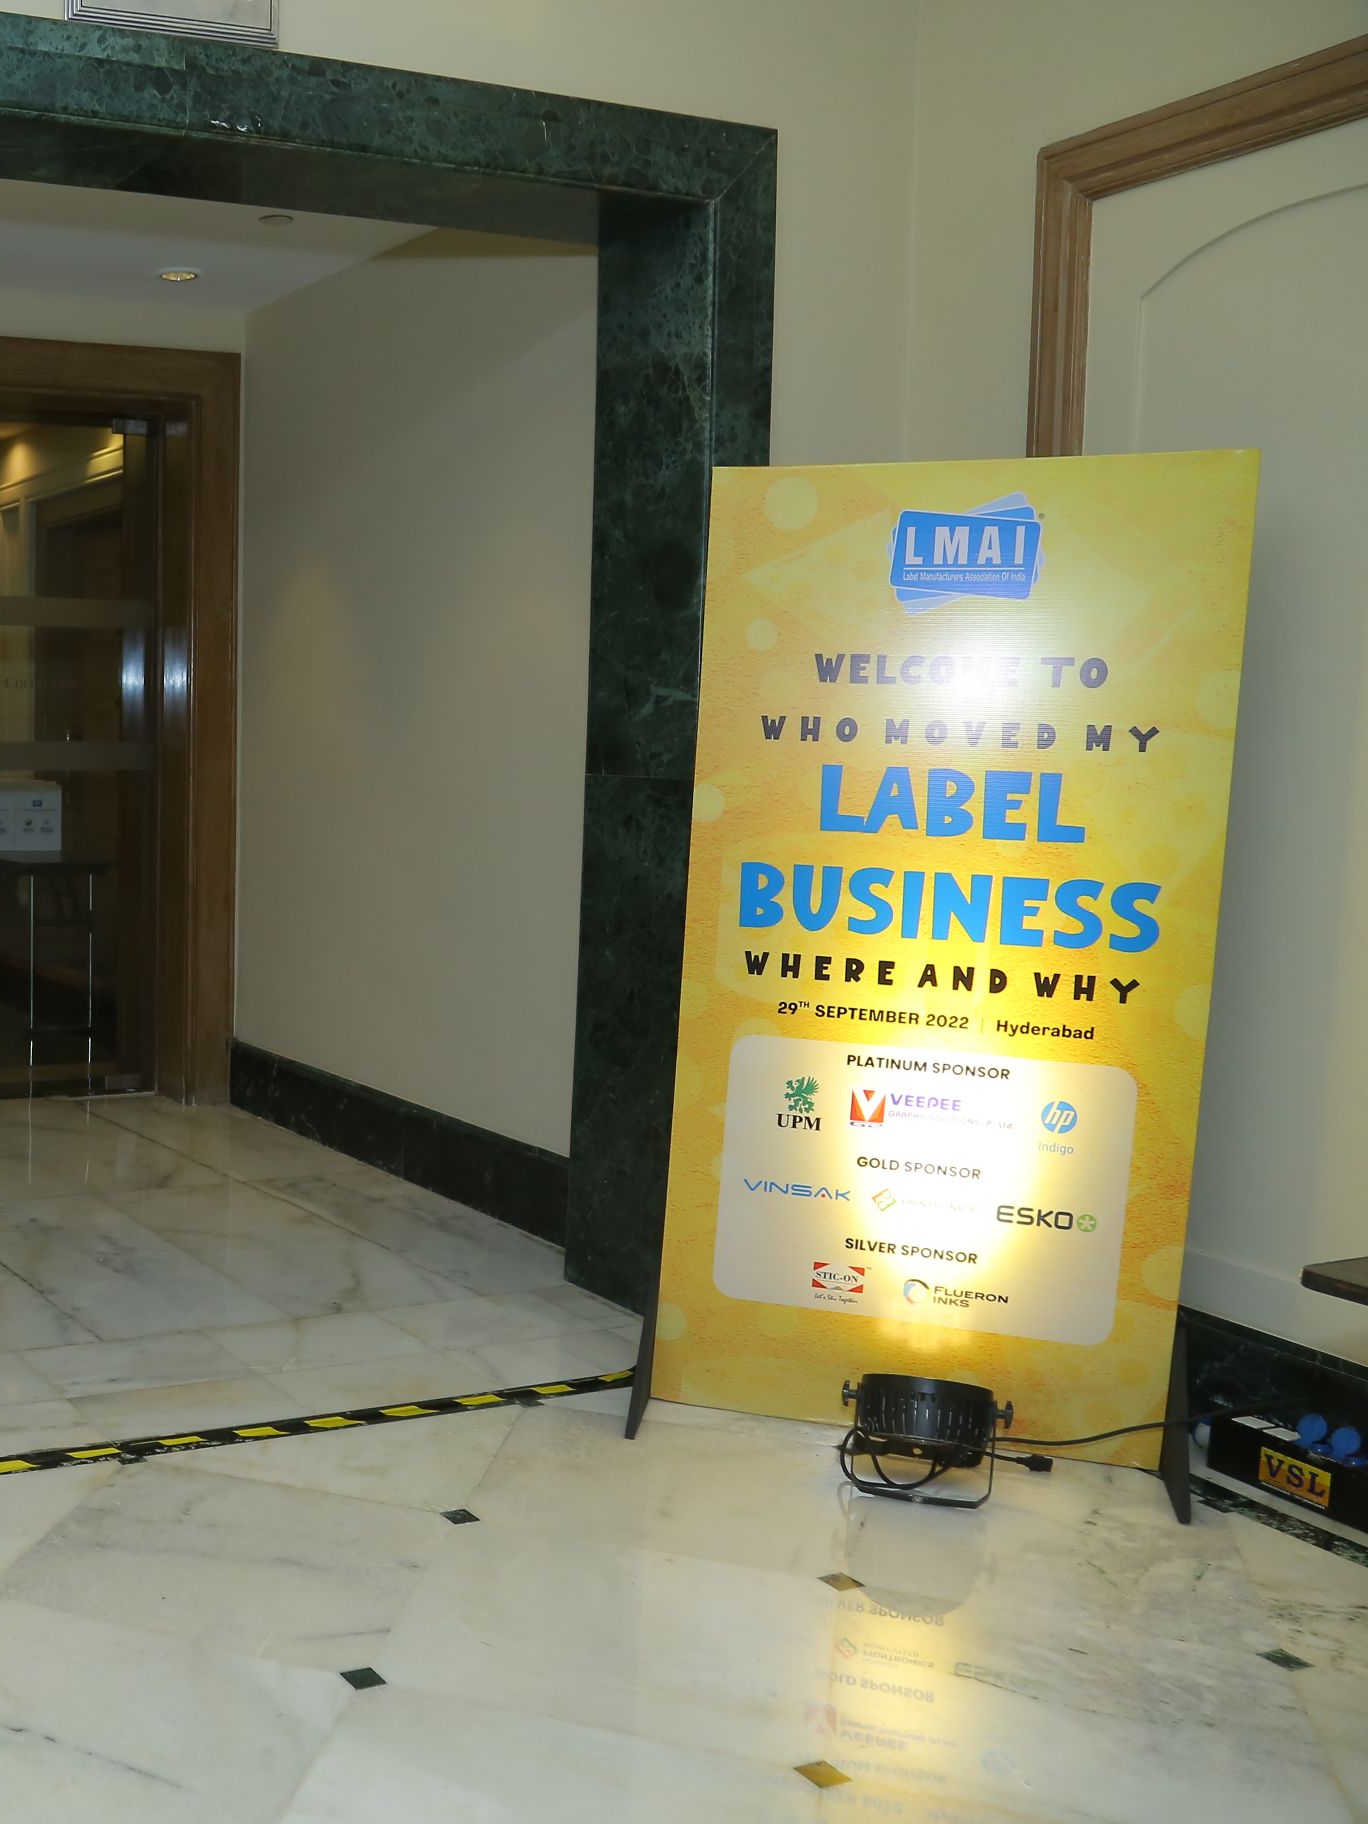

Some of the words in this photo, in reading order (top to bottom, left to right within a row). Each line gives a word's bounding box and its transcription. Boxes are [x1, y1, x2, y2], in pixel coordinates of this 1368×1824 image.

[903, 525, 1026, 565] LMAI
[903, 571, 920, 582] Label
[920, 571, 964, 582] Manufacturers
[965, 571, 1001, 582] Association
[1001, 571, 1010, 582] Of
[1010, 571, 1027, 582] India
[1040, 656, 1109, 689] TO
[760, 715, 859, 744] WHO
[884, 718, 1057, 751] MOVED
[1085, 724, 1161, 753] MY
[819, 763, 1087, 844] LABEL
[738, 861, 1162, 954] BUSINESS
[744, 950, 896, 987] WHERE
[917, 963, 1009, 995] AND
[1033, 971, 1141, 1005] WHY
[776, 1000, 811, 1018] 29TH
[814, 1003, 920, 1026] SEPTEMBER
[925, 1013, 970, 1030] 2022
[996, 1019, 1096, 1041] Hyderabad
[846, 1054, 928, 1073] PLATINUM
[932, 1062, 1011, 1081] SPONSOR
[889, 1093, 962, 1112] VEEPEE
[775, 1112, 822, 1132] UPM
[1044, 1102, 1077, 1134] hp
[1037, 1141, 1075, 1156] Indigo
[856, 1156, 900, 1172] GOLD
[904, 1161, 982, 1181] SPONSOR
[742, 1178, 852, 1202] VINSAK
[996, 1204, 1074, 1231] ESKO
[844, 1237, 897, 1255] SILVER
[901, 1244, 979, 1265] SPONSOR
[815, 1270, 860, 1284] STIC-ON
[932, 1295, 971, 1309] INKS
[933, 1285, 1010, 1304] FLUERON
[1264, 1453, 1326, 1499] VSL
